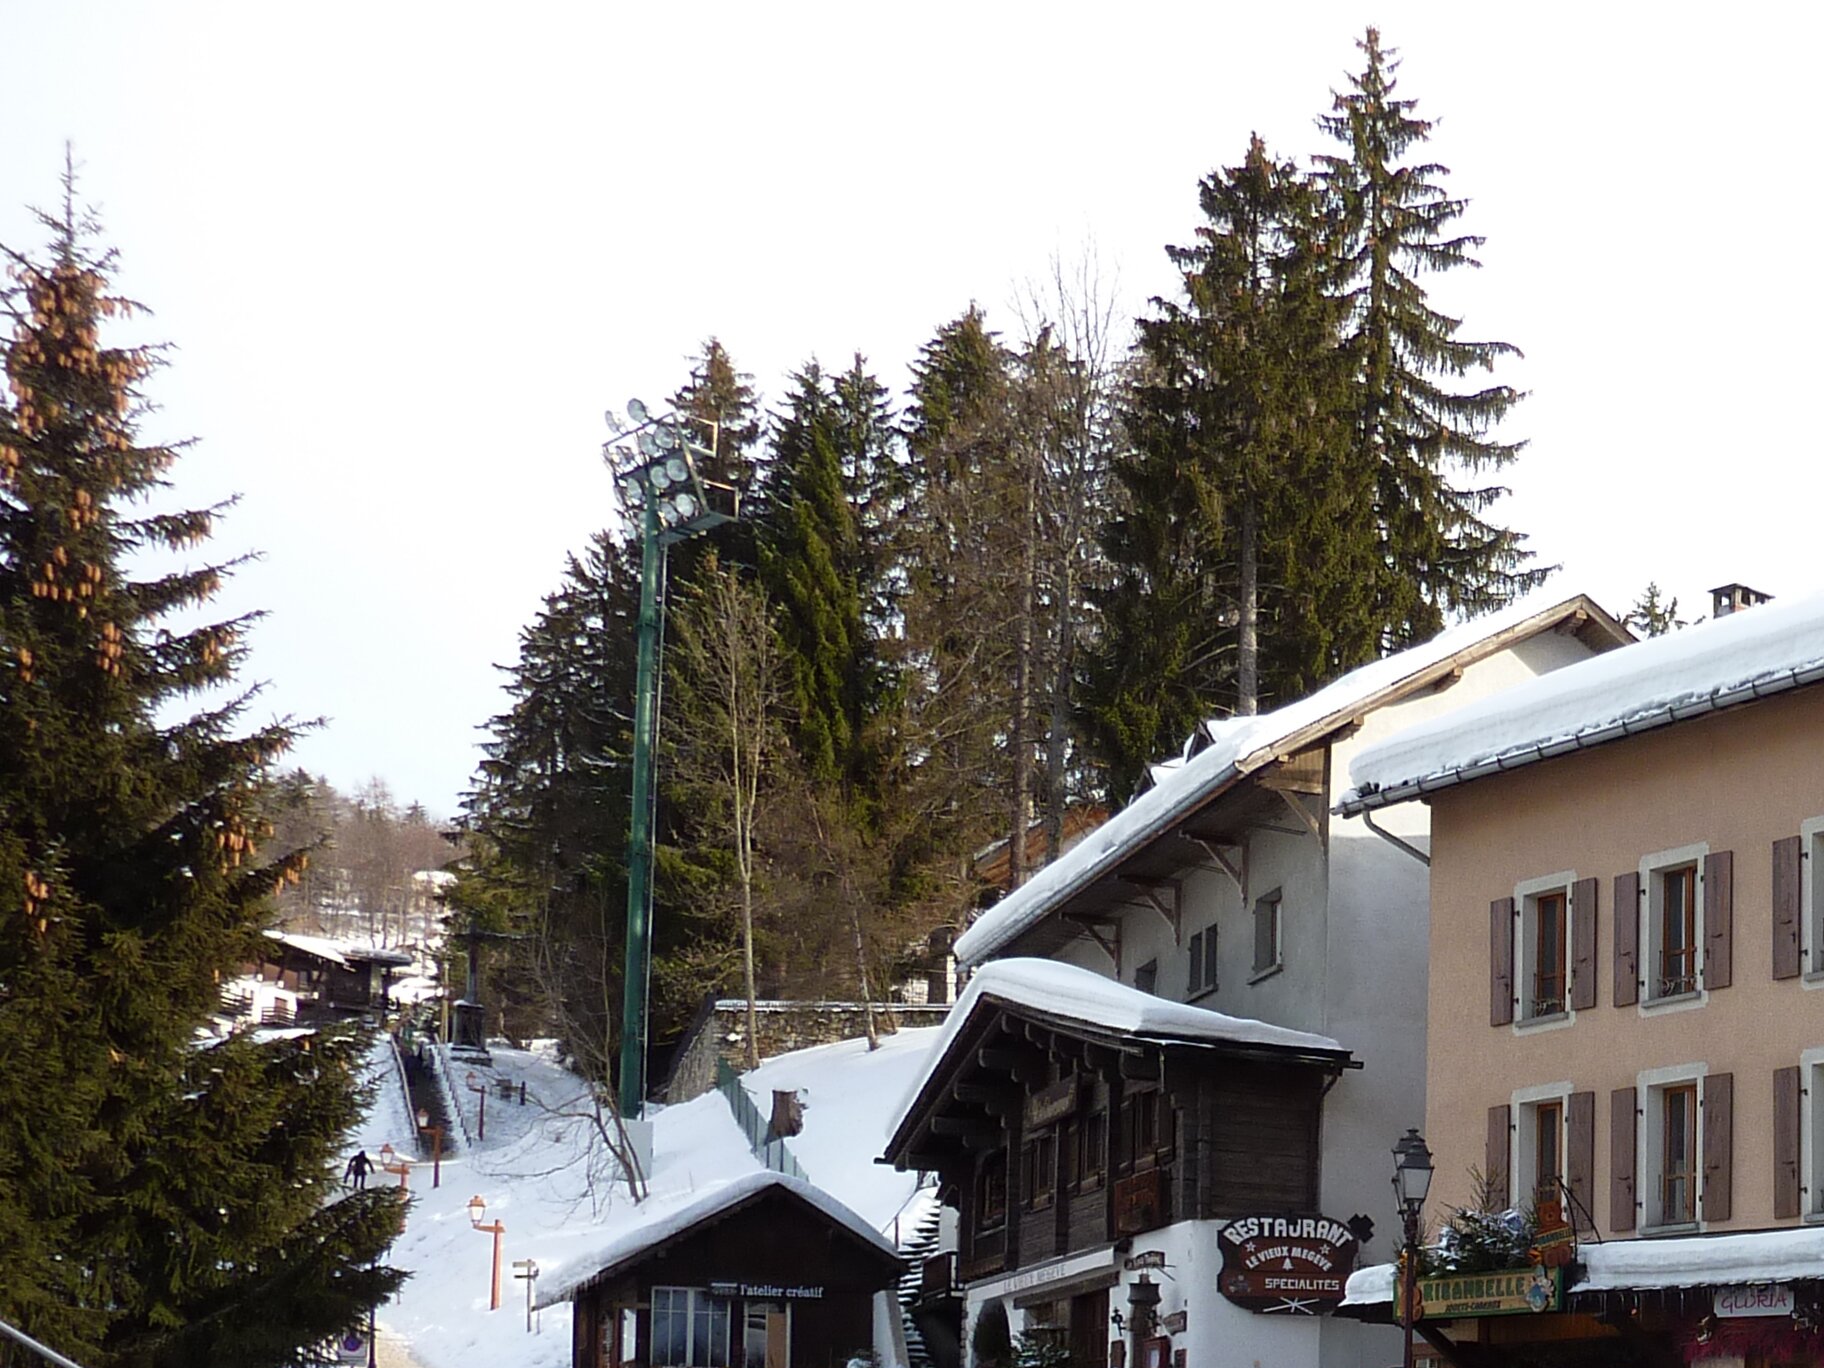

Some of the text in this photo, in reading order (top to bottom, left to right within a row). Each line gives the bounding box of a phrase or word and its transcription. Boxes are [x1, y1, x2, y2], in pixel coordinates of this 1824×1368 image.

[1223, 1217, 1353, 1248] RESTAURANT
[1245, 1256, 1260, 1270] LE
[1257, 1246, 1290, 1263] VIEUX
[740, 1283, 784, 1297] l'atelier
[785, 1285, 824, 1299] créatif
